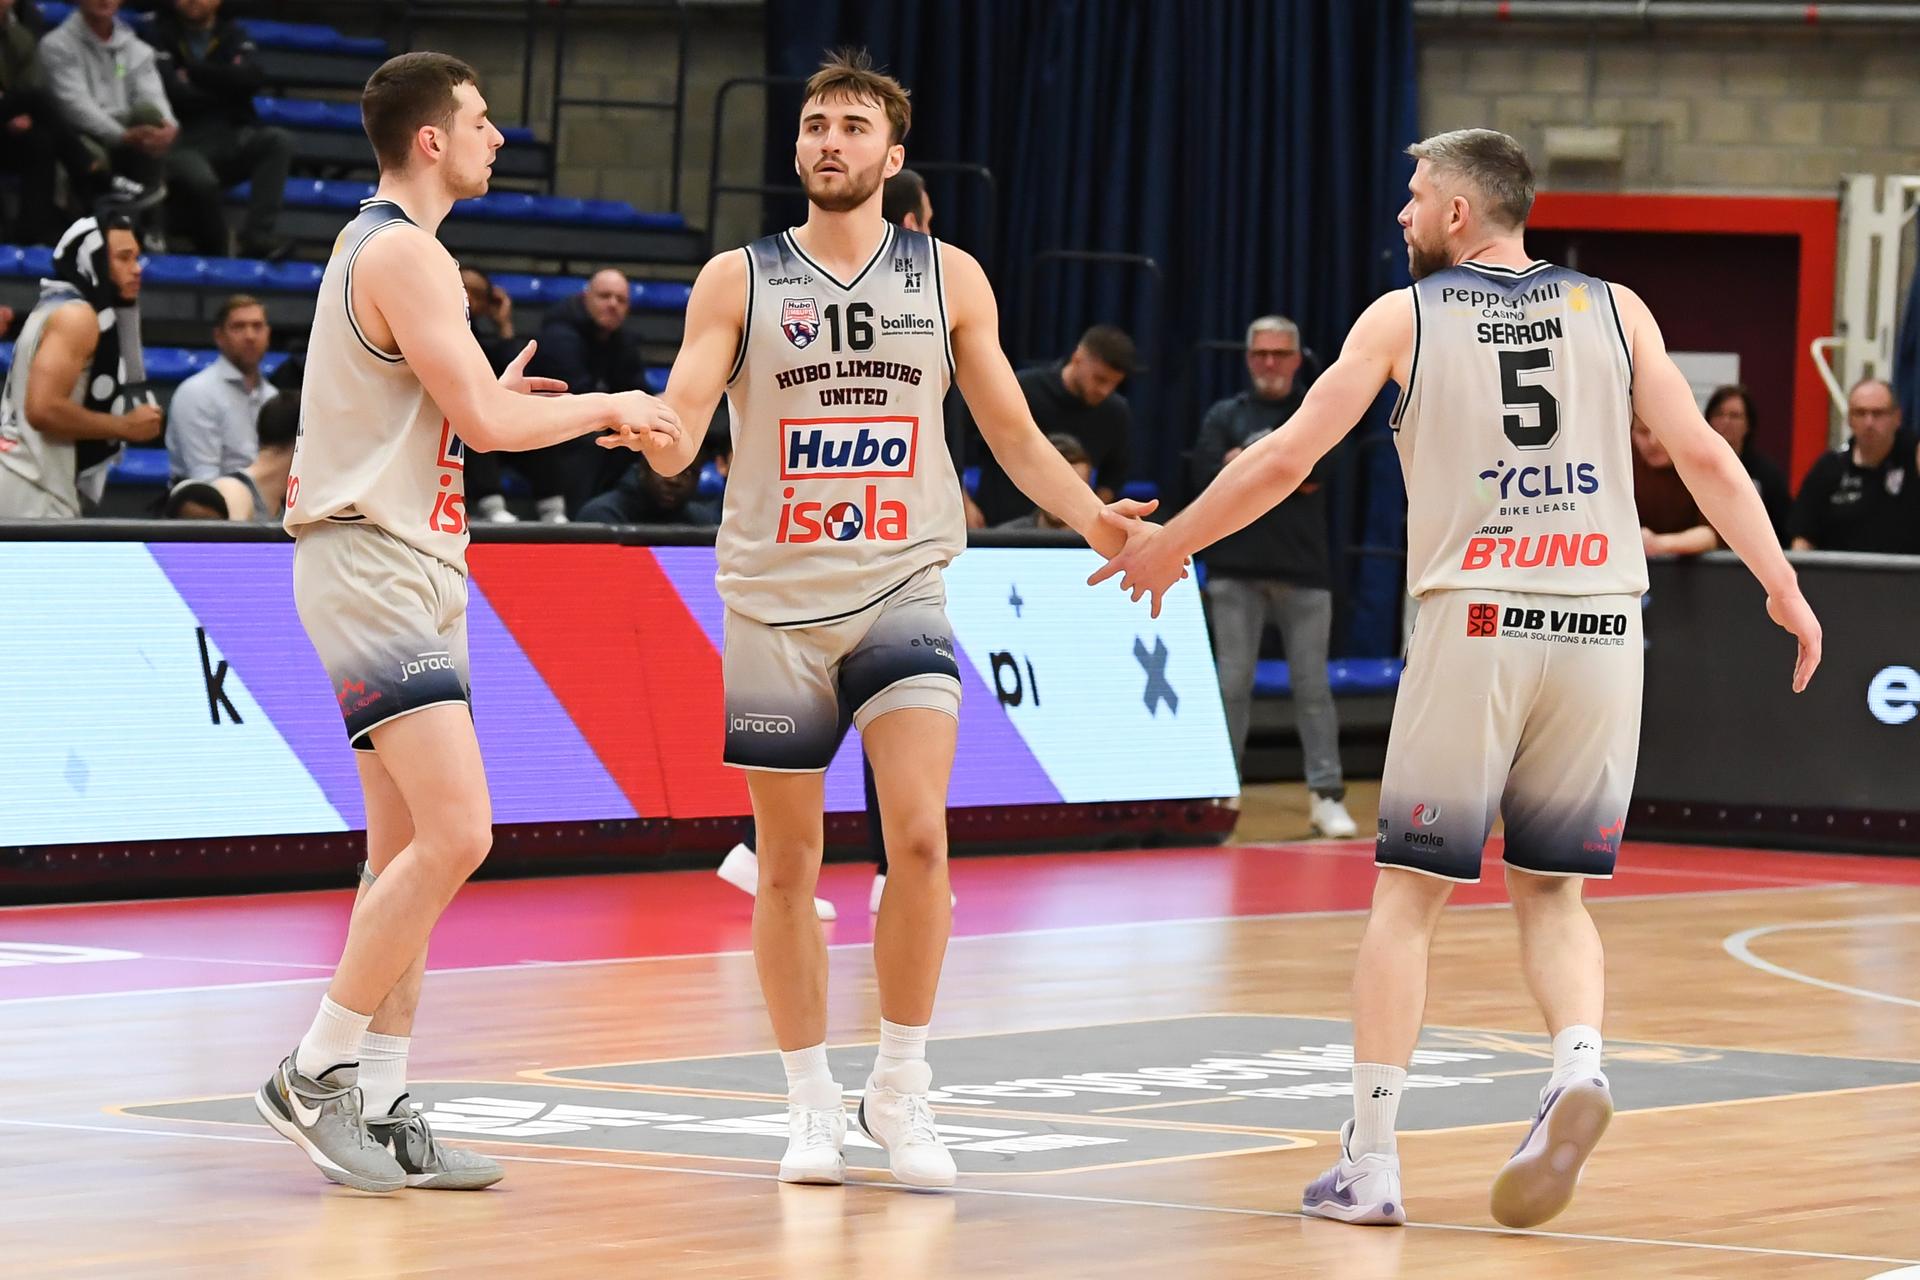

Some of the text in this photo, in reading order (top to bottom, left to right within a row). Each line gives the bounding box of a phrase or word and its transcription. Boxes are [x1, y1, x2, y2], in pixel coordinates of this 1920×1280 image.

[768, 276, 802, 286] CRAFT
[823, 301, 877, 353] 16
[881, 313, 934, 329] baillien
[1482, 309, 1525, 321] CASINO
[1477, 317, 1563, 345] SERRON
[775, 360, 923, 390] HUBO LIMBURG
[819, 387, 888, 406] UNITED
[1498, 347, 1561, 451] 5
[788, 428, 908, 469] Hubo
[776, 485, 909, 544] isola
[1500, 502, 1576, 516] BIKE LEASE
[1474, 525, 1514, 535] ROUP
[1460, 533, 1609, 571] BRUNO
[1502, 607, 1627, 636] DB VIDEO
[1501, 629, 1625, 646] MEDIA SOLUTIONS & FACILITIES
[729, 711, 796, 735] jaraco
[1405, 832, 1444, 847] evoke
